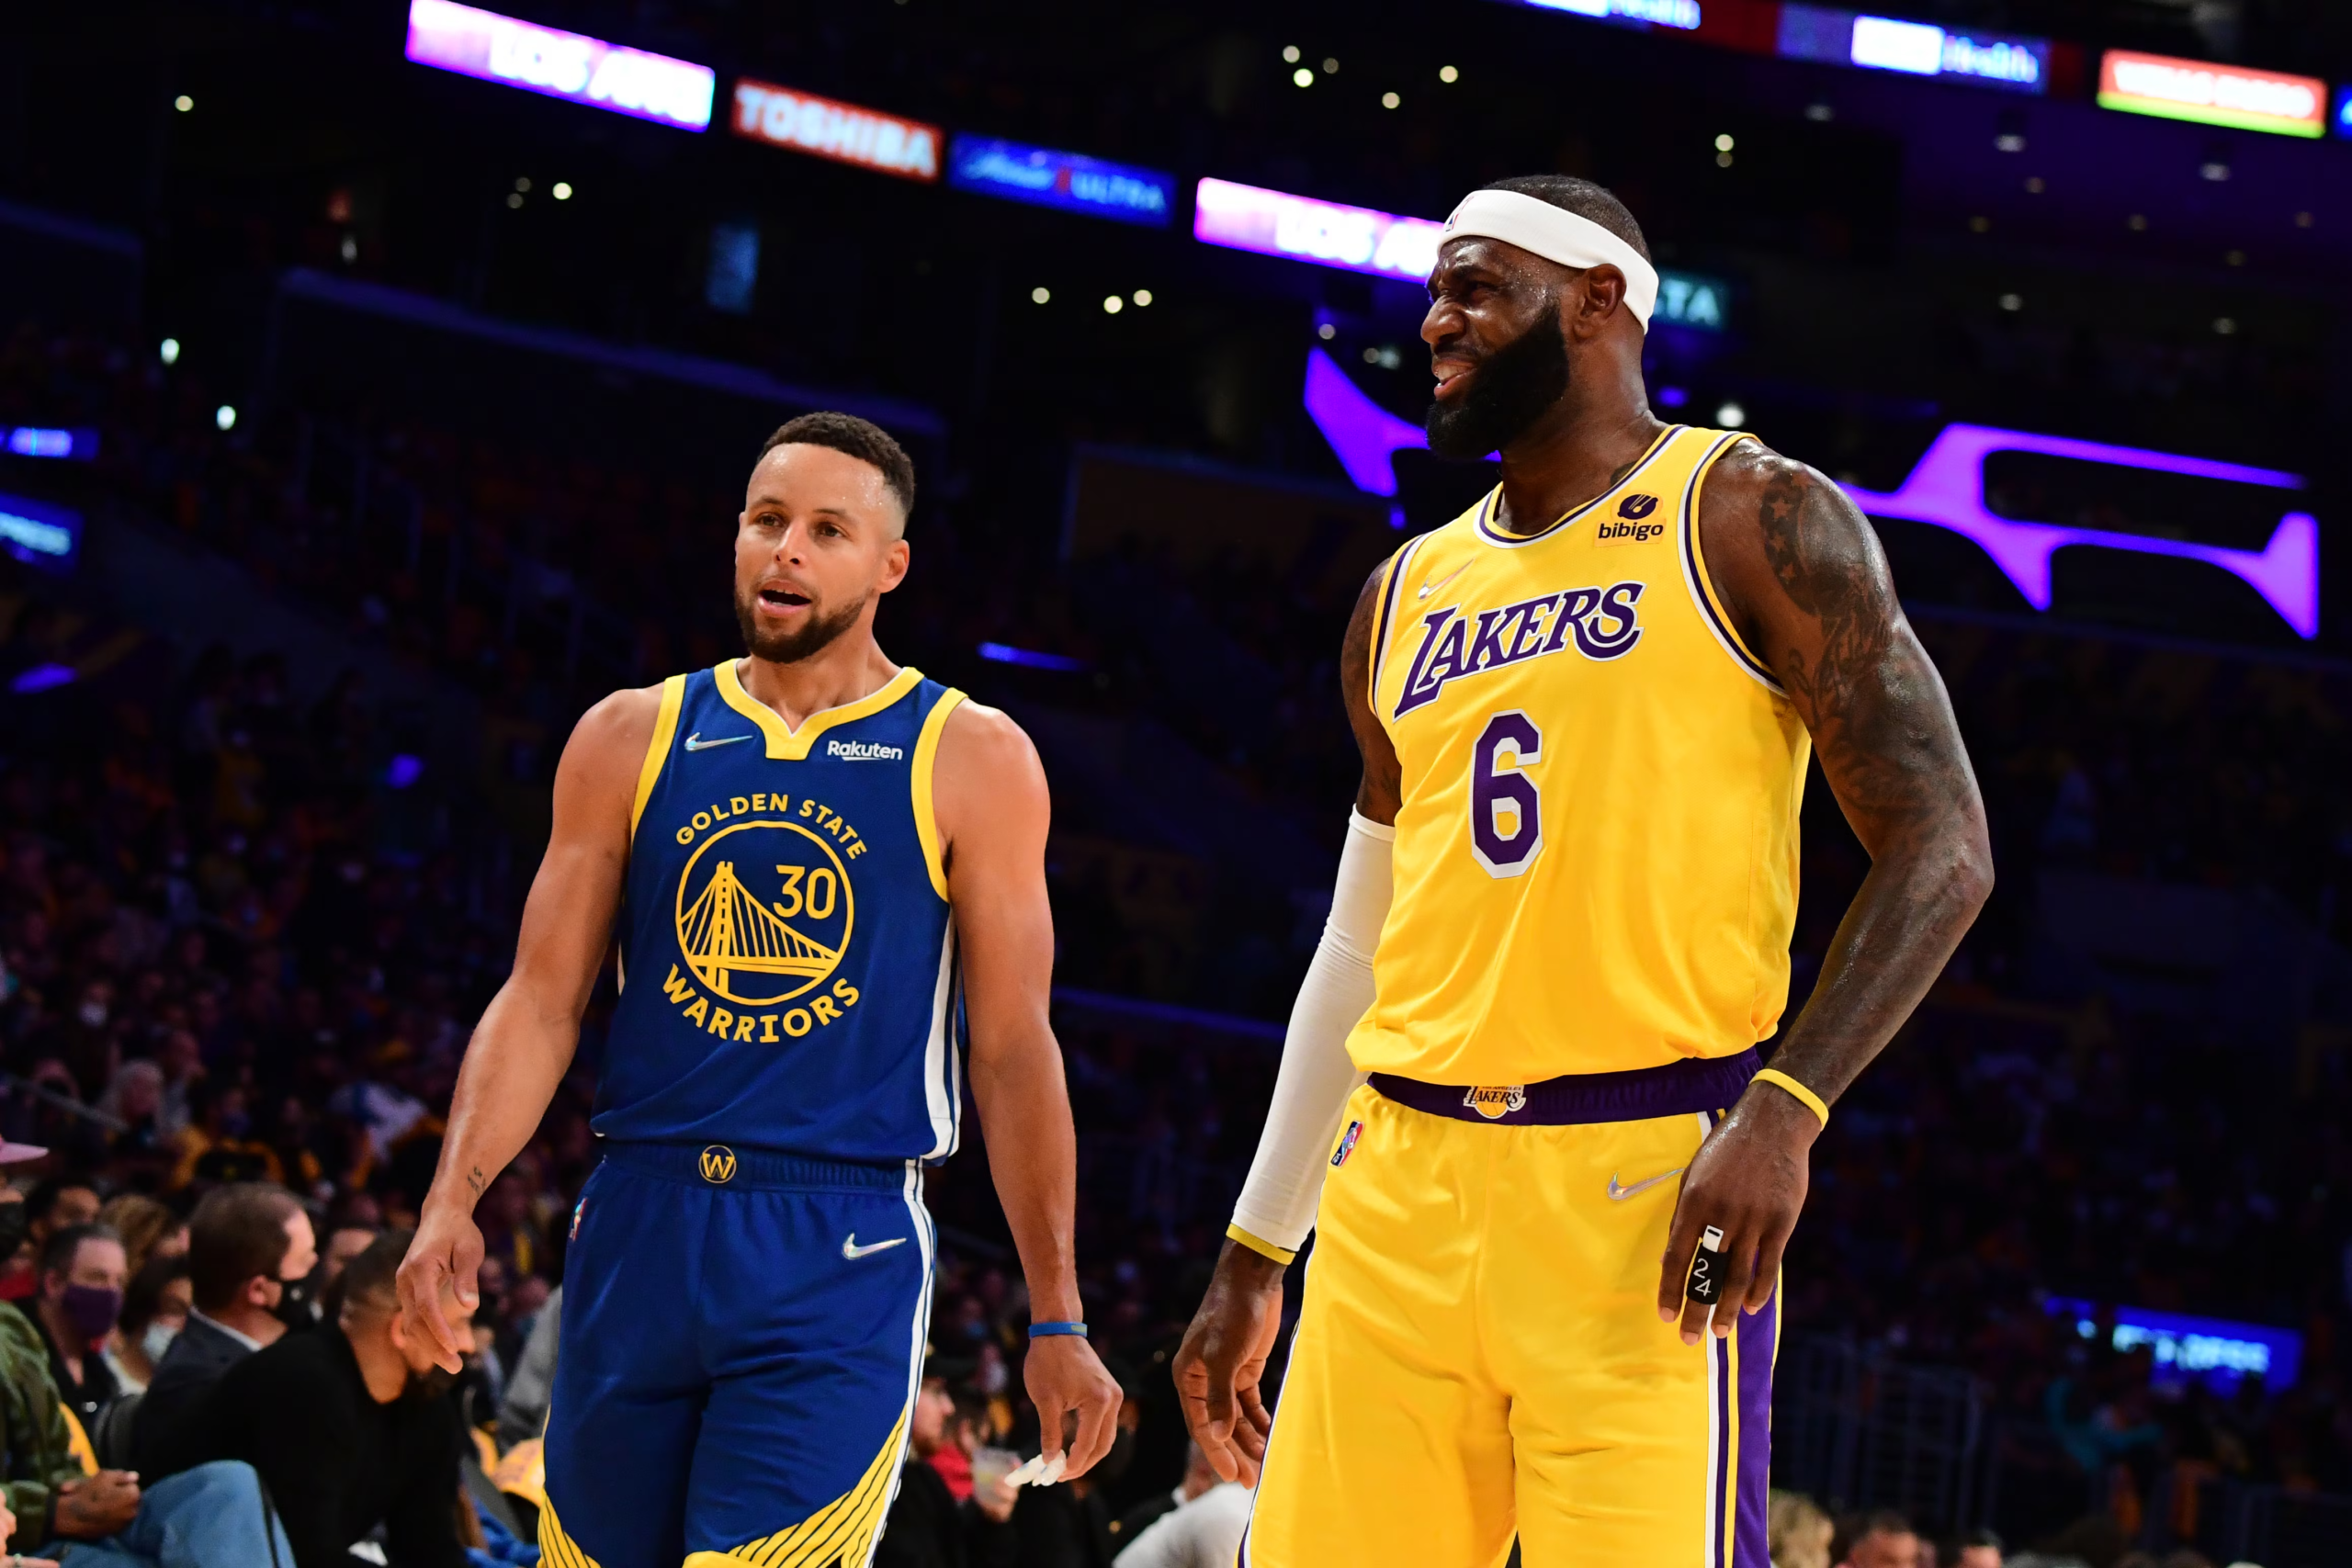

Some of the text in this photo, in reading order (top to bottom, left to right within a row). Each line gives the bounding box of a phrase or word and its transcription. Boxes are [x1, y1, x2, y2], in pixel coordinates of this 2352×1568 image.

[736, 84, 935, 177] TOSHIBA
[1599, 522, 1664, 541] bibigo
[1393, 581, 1646, 724] LAKERS
[827, 740, 903, 761] Rakuten
[1470, 708, 1543, 879] 6
[676, 793, 867, 860] GOLDEN STATE
[773, 864, 837, 919] 30
[662, 963, 860, 1043] WARRIORS
[1465, 1086, 1523, 1109] LAKERS
[701, 1153, 735, 1179] W
